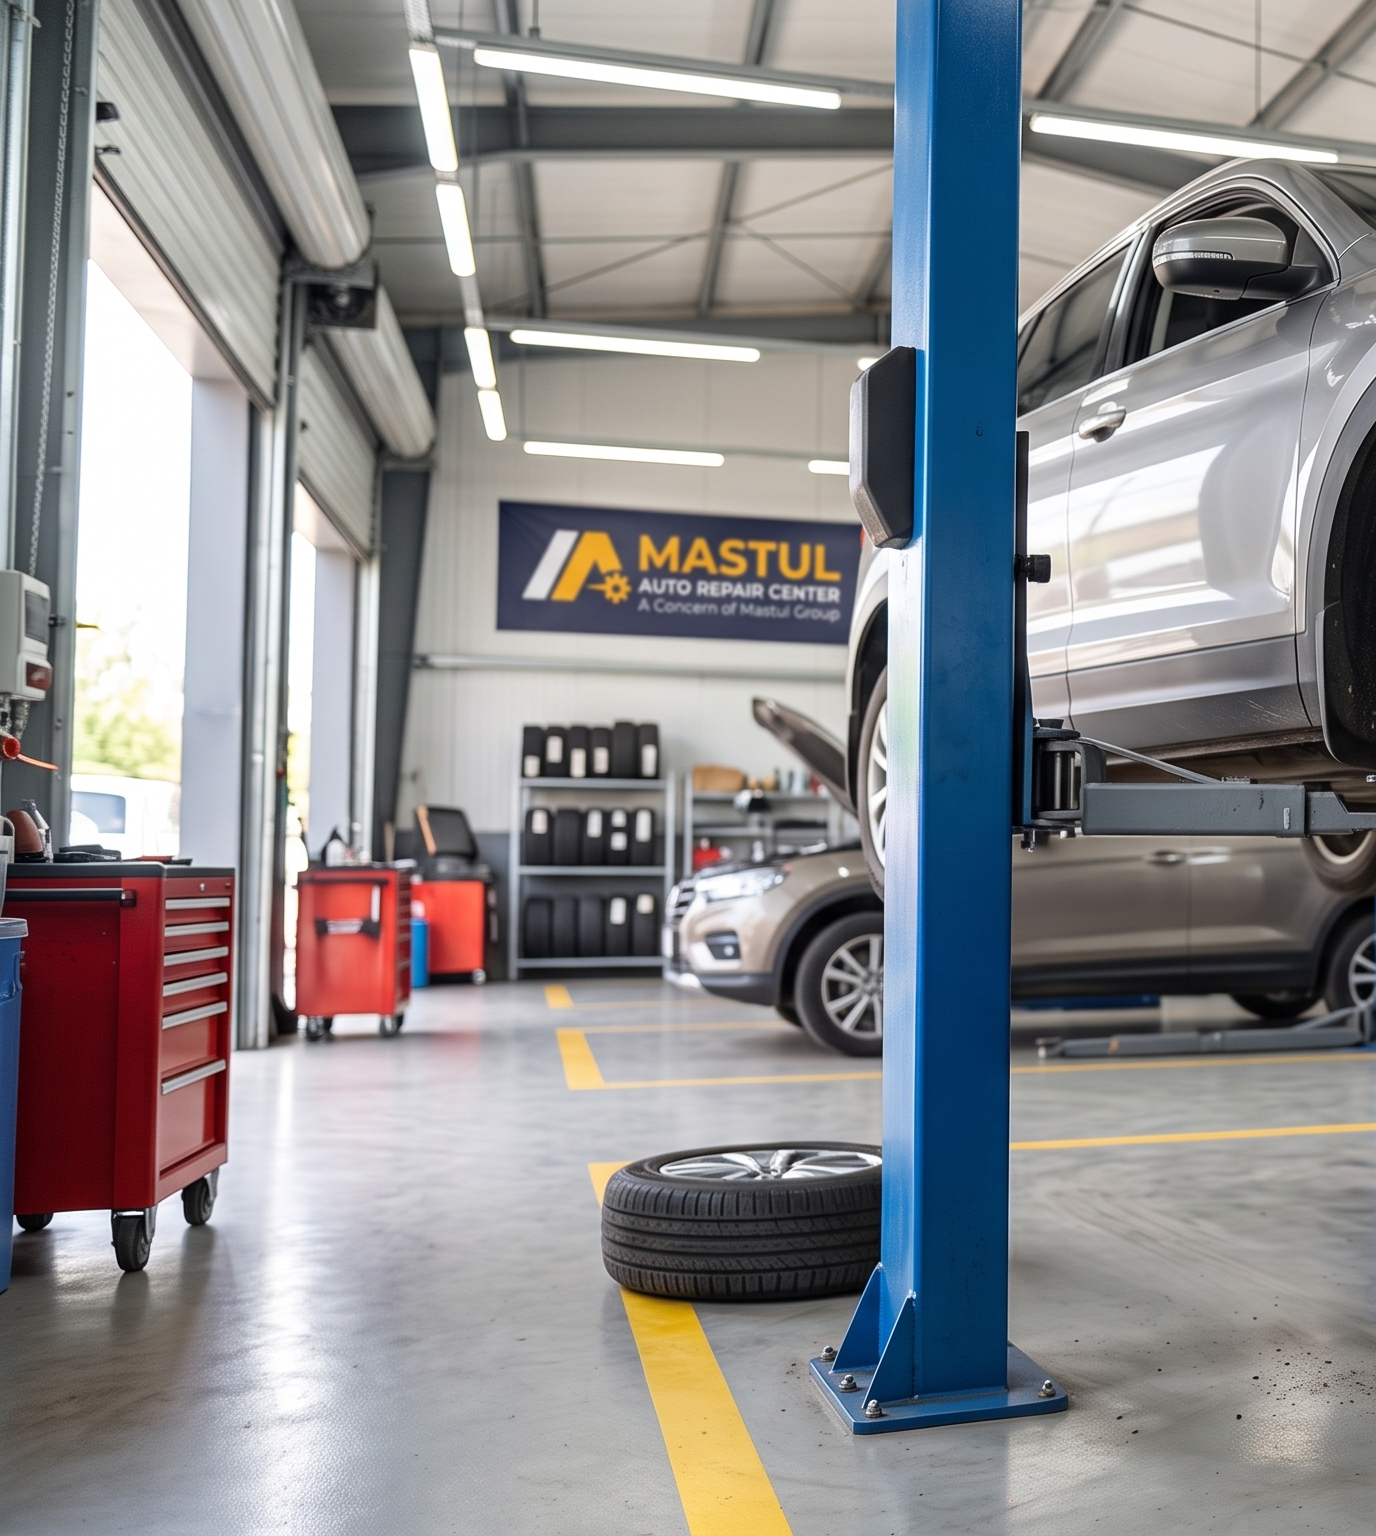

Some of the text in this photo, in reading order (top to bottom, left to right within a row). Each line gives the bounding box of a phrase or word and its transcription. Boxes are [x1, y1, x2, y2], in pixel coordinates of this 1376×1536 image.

[638, 534, 841, 582] MASTUL
[638, 578, 841, 603] AUTO REPAIR CENTER
[638, 599, 841, 623] A Concern of Mastul Group
